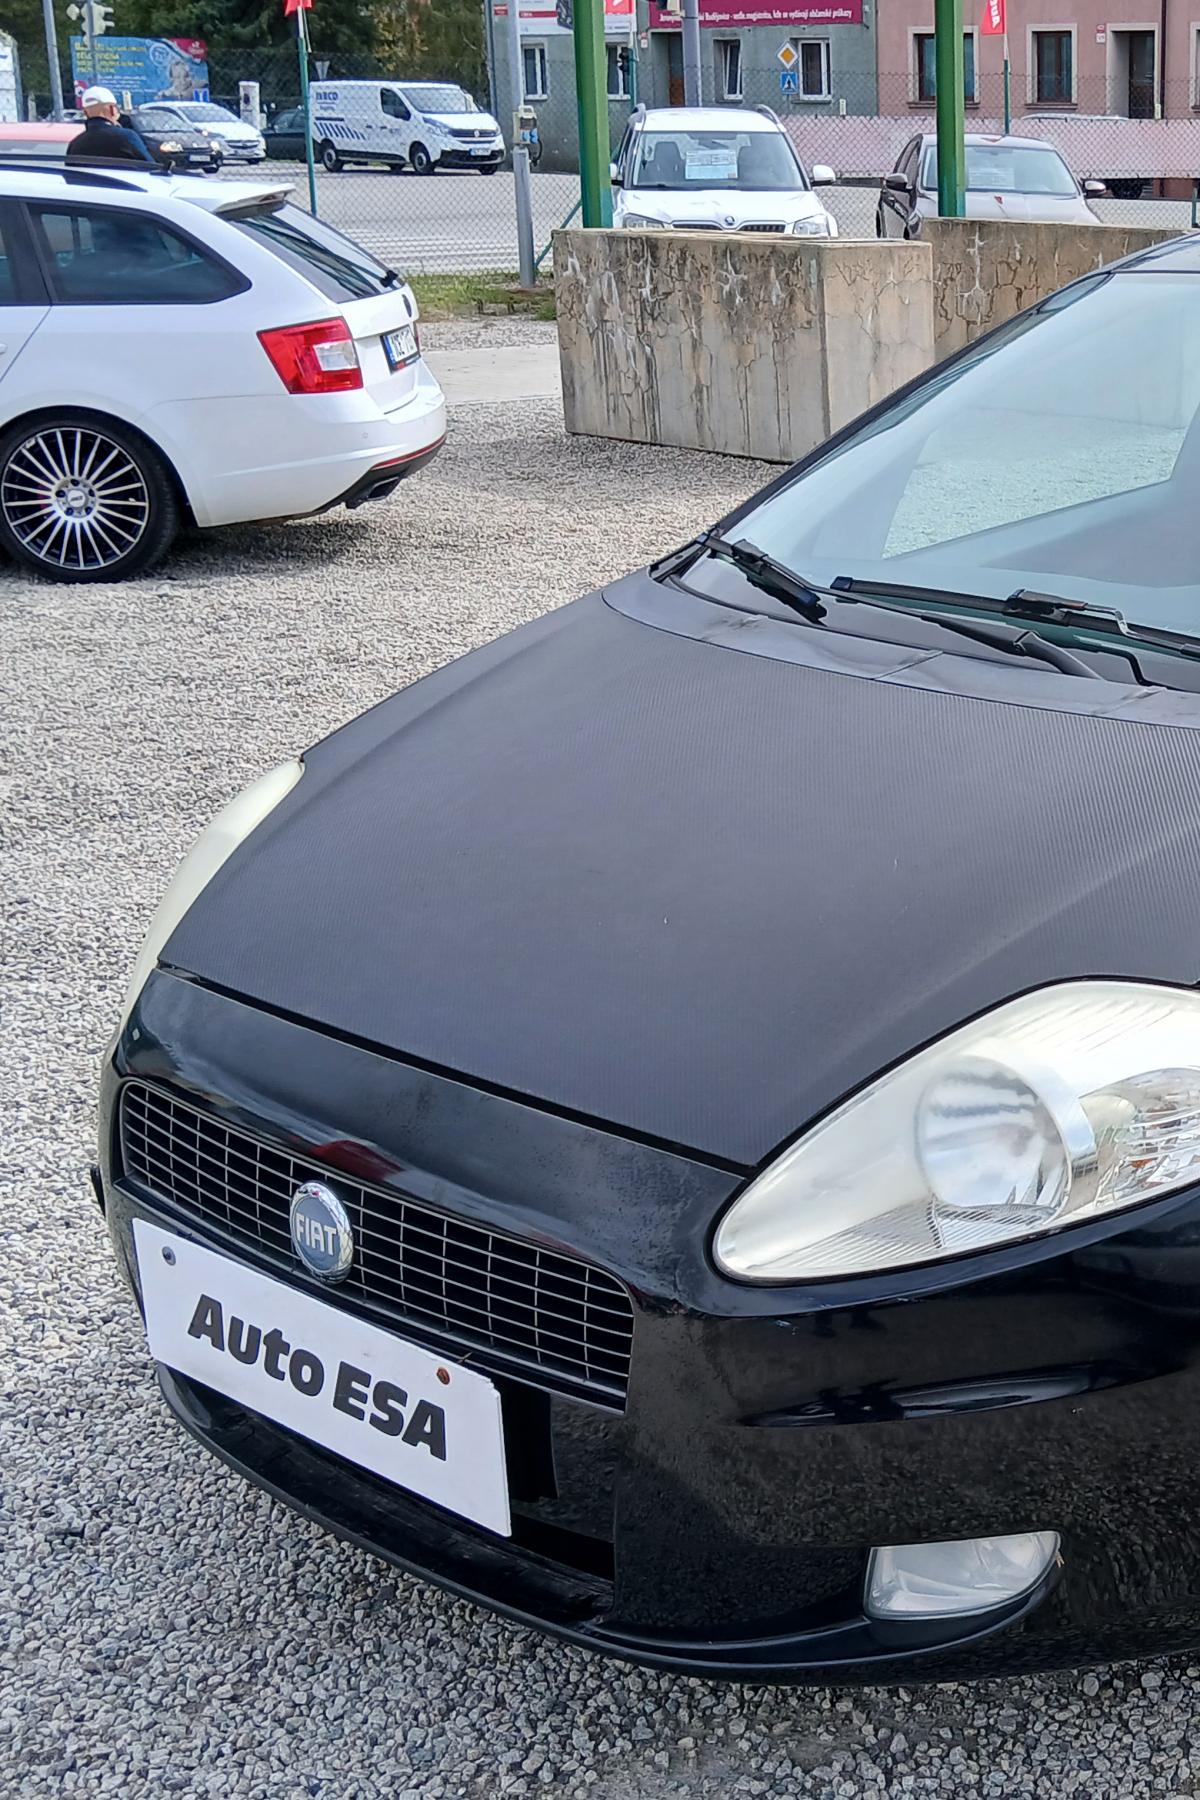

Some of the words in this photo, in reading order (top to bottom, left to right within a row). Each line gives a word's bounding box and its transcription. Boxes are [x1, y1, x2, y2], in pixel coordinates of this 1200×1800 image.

[295, 1212, 337, 1256] FIAT
[188, 1294, 325, 1397] Auto
[332, 1361, 447, 1461] ESA
